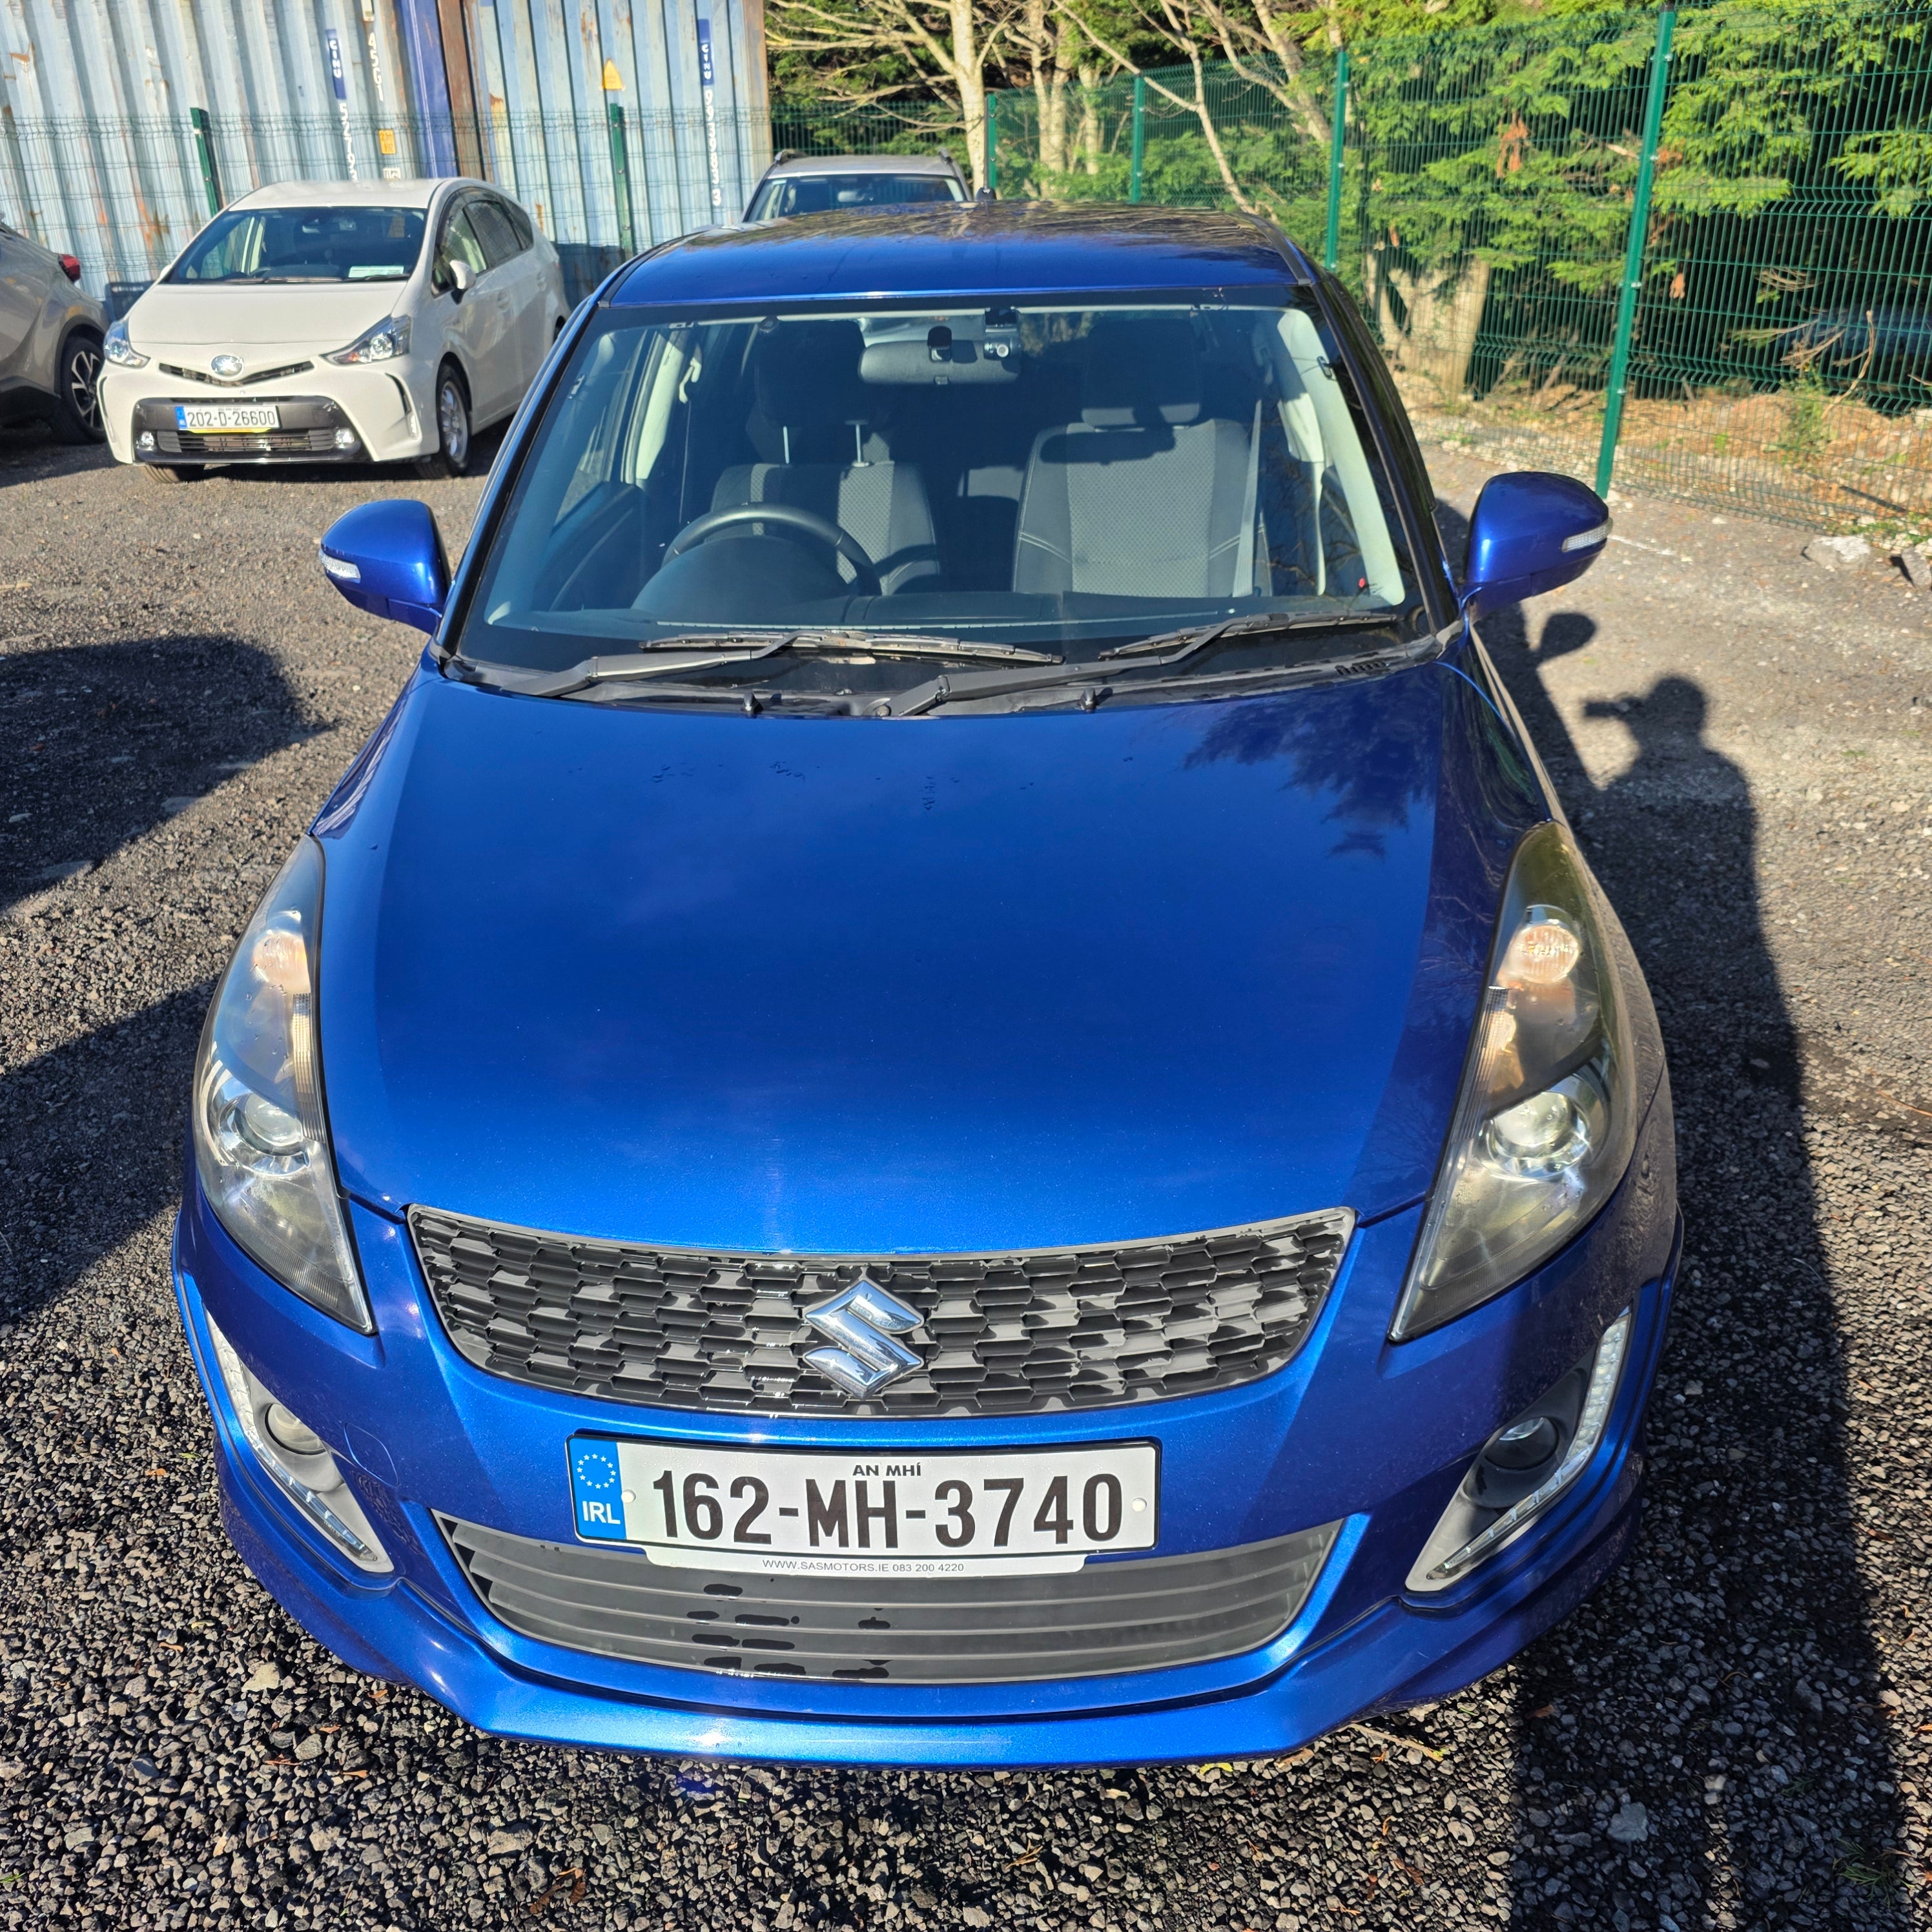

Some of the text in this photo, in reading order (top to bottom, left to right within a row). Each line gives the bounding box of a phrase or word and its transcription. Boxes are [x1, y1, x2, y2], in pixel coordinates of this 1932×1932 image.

[368, 32, 384, 101] 45G1
[187, 411, 276, 427] 202-D-26600
[852, 1462, 921, 1476] AN MHÍ
[582, 1500, 621, 1525] IRL
[653, 1470, 1122, 1548] 162-MH-3740
[762, 1559, 965, 1572] WWW.SASMOTORS.IE 083 200 4220
